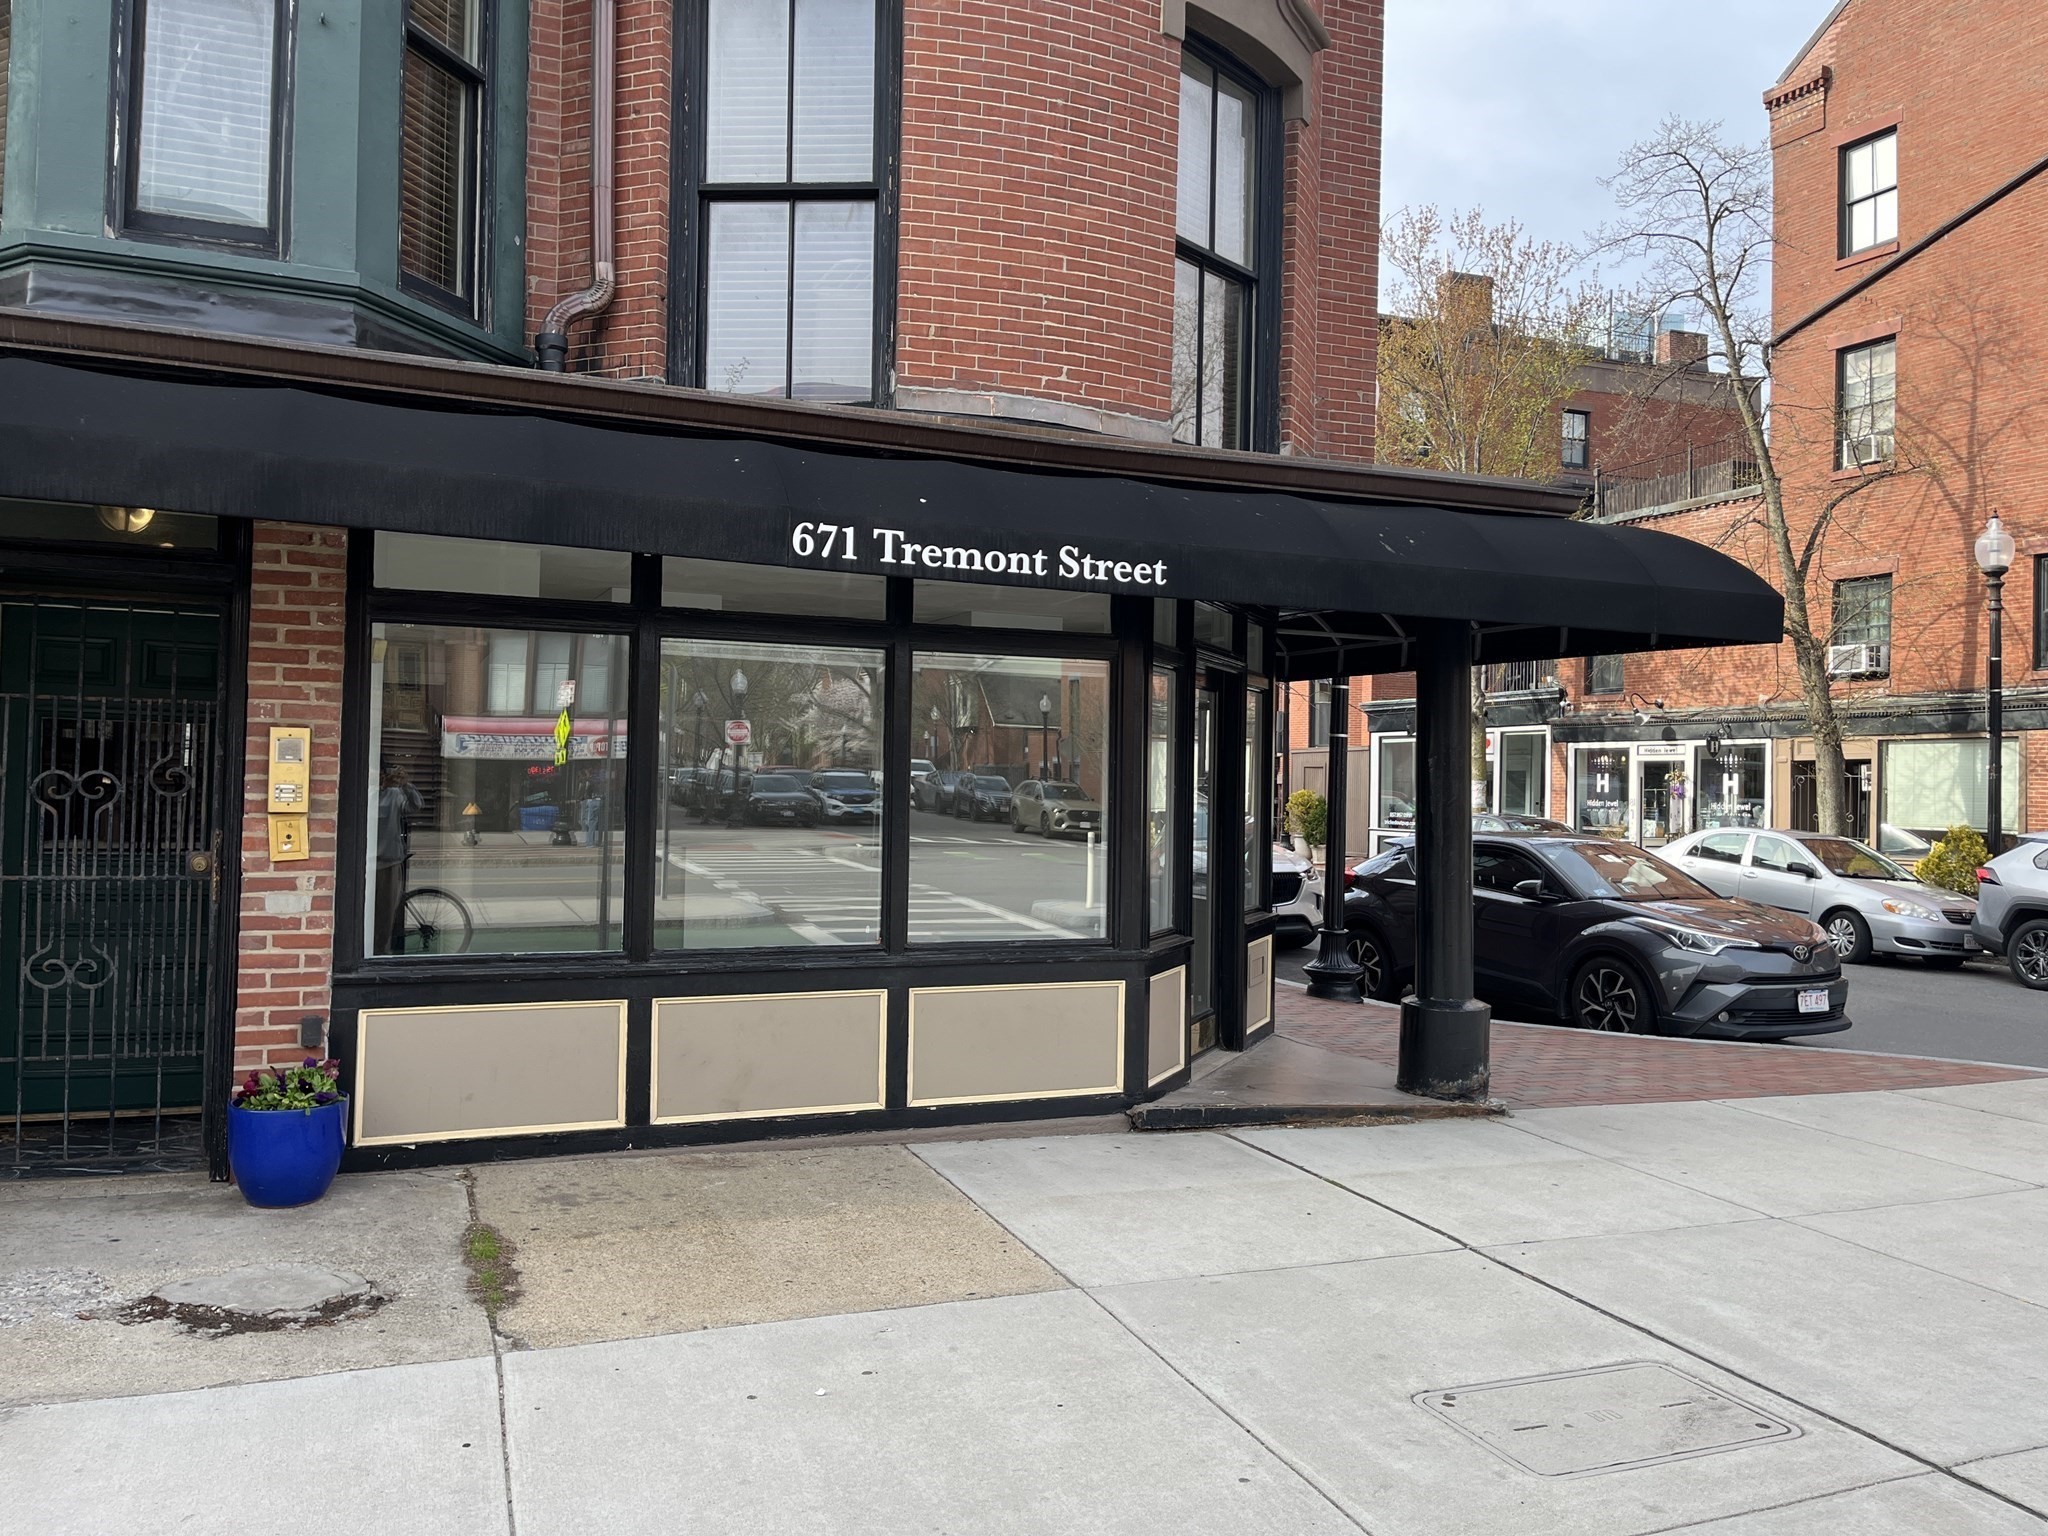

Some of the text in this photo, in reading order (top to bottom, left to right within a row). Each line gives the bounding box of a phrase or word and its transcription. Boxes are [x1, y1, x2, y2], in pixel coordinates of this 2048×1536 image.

[792, 522, 1167, 585] 671 Tremont Street
[1711, 741, 1719, 753] H
[1596, 773, 1610, 793] H
[1723, 773, 1739, 795] H
[1586, 799, 1619, 808] Hidden Jewel
